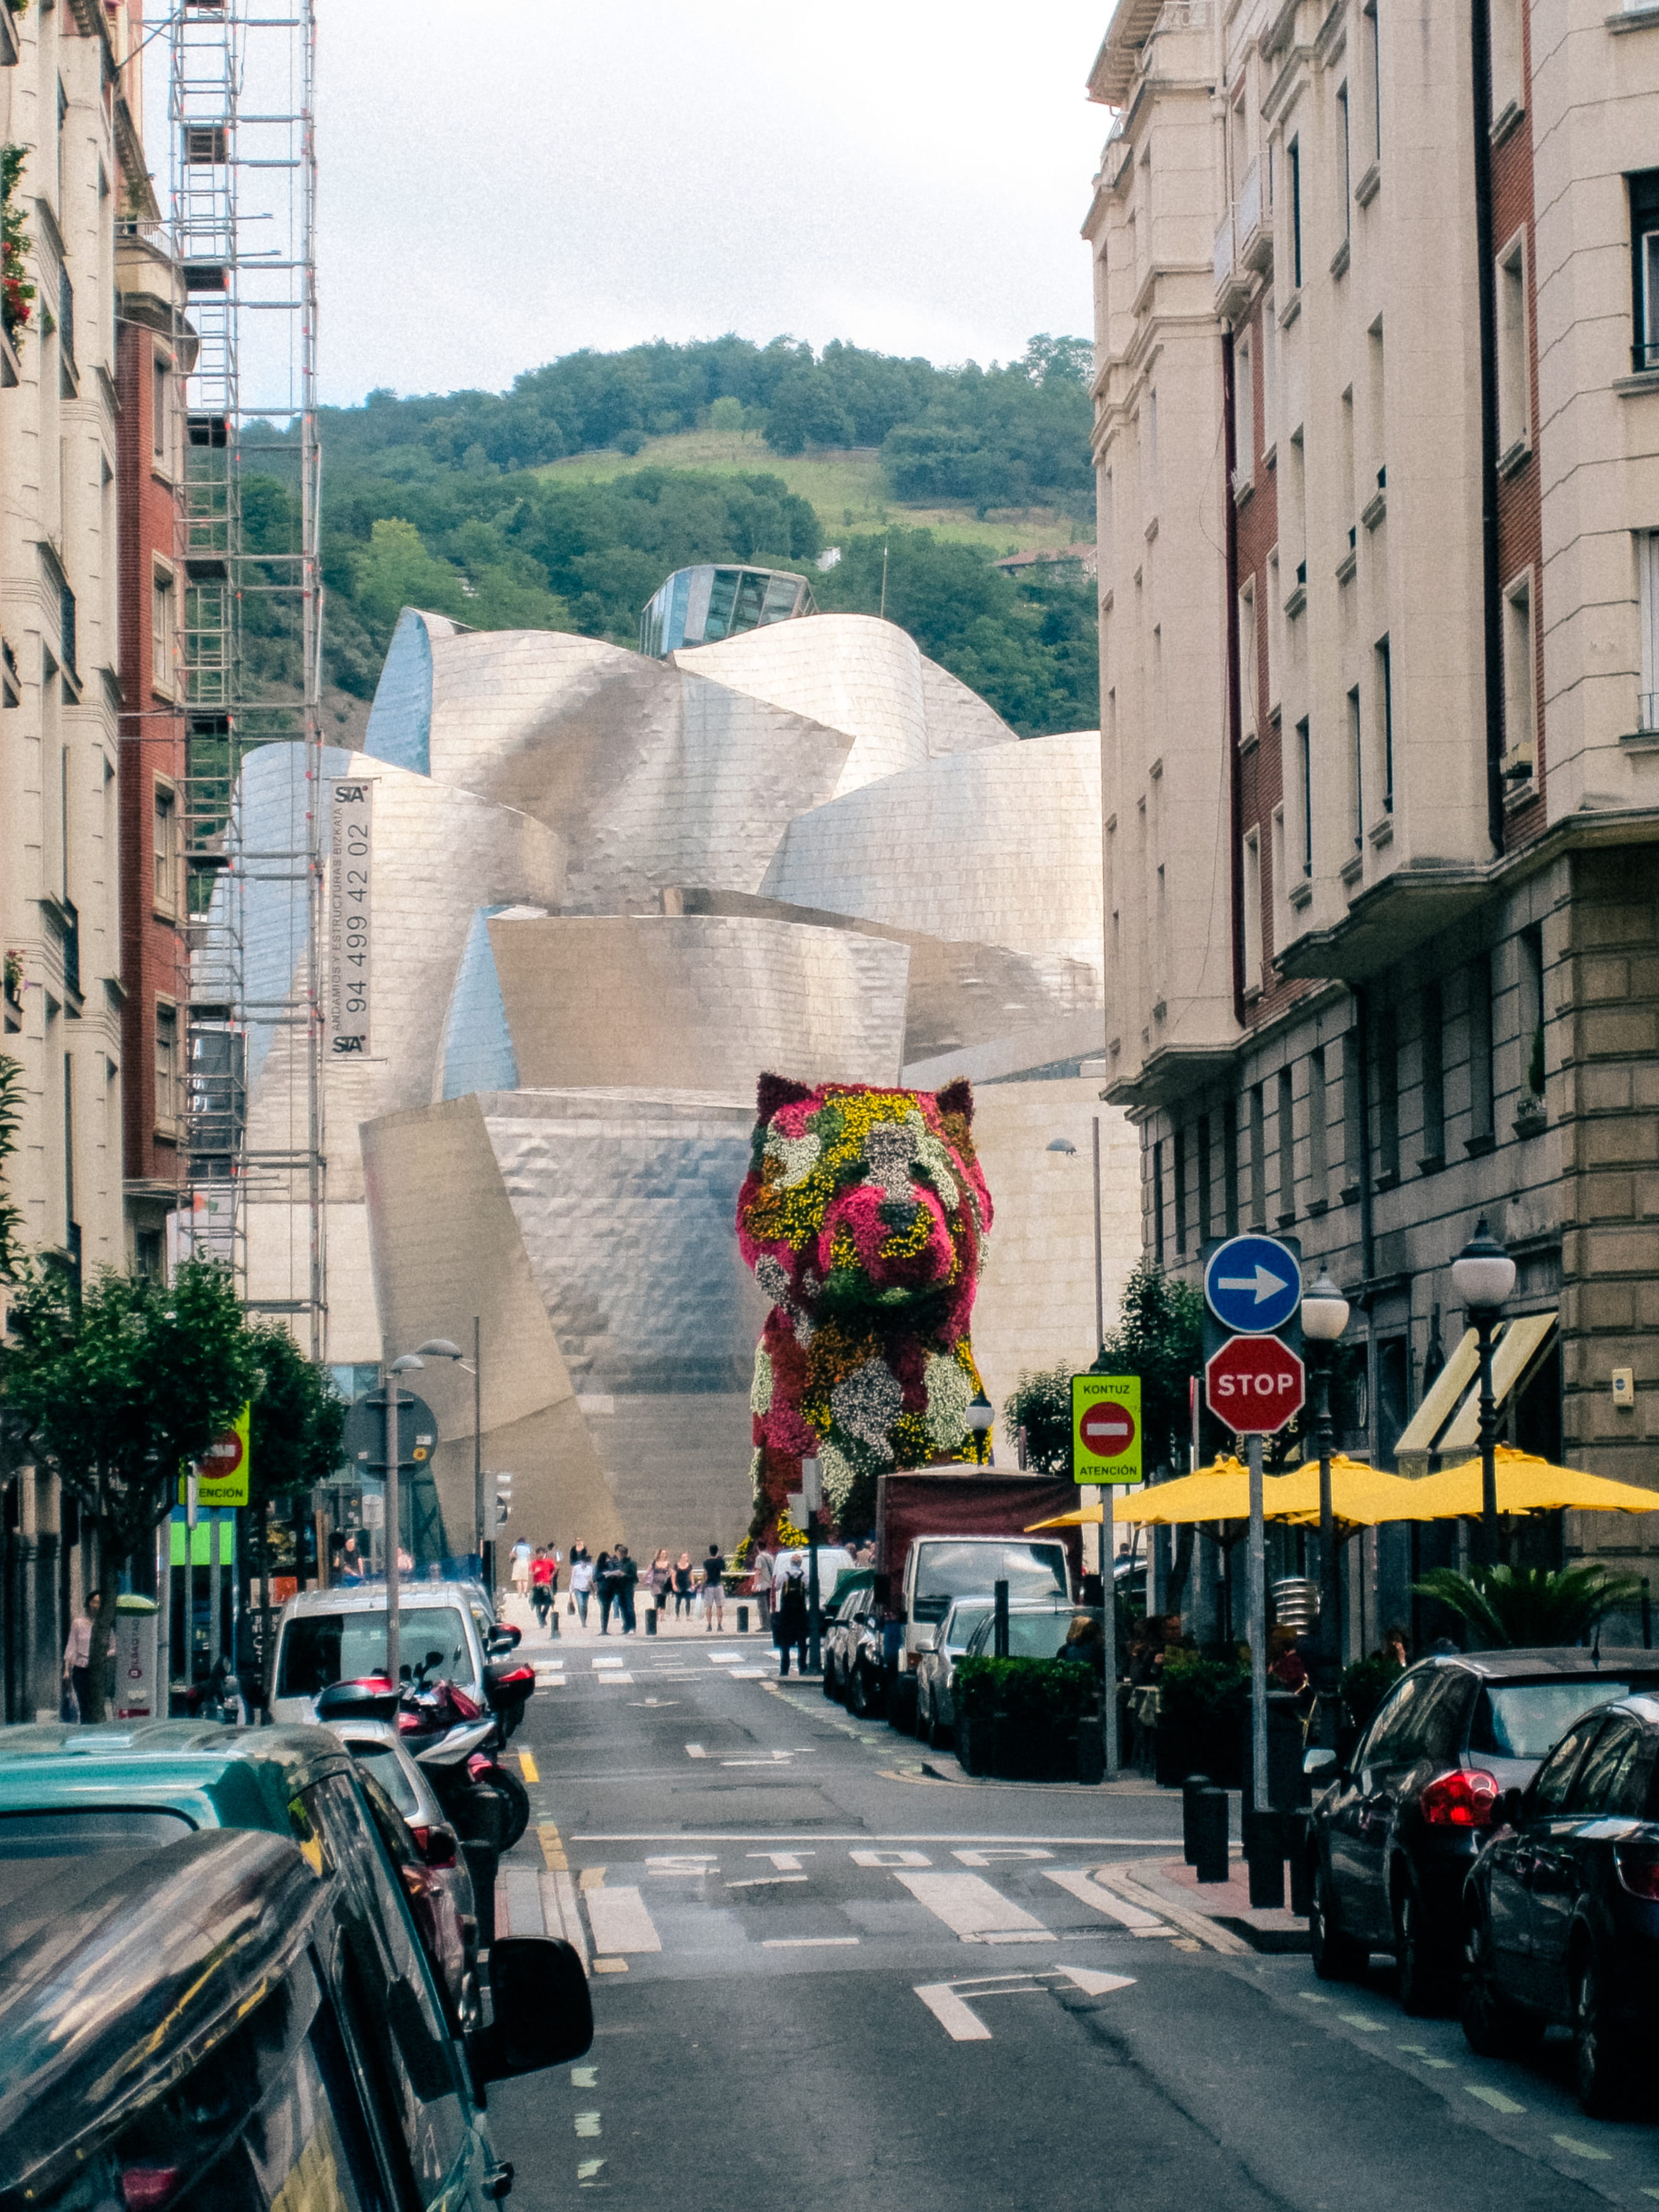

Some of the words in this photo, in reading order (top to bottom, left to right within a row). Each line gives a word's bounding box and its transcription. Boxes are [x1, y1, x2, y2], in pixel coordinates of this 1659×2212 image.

[334, 787, 364, 803] STA
[333, 807, 343, 855] BIZKAIA
[348, 824, 368, 856] 02
[347, 870, 367, 902] 42
[332, 859, 342, 951] ESTRUCTURAS
[346, 916, 367, 967] 499
[331, 966, 341, 1031] ANDAMIOS
[346, 981, 366, 1013] 94
[332, 1035, 362, 1053] STA
[1083, 1385, 1130, 1394] KONTUZ
[1217, 1373, 1294, 1396] STOP
[1080, 1465, 1137, 1476] ATENCIÓN
[197, 1487, 244, 1497] ENCIÓN
[644, 1849, 1055, 1876] STOP
